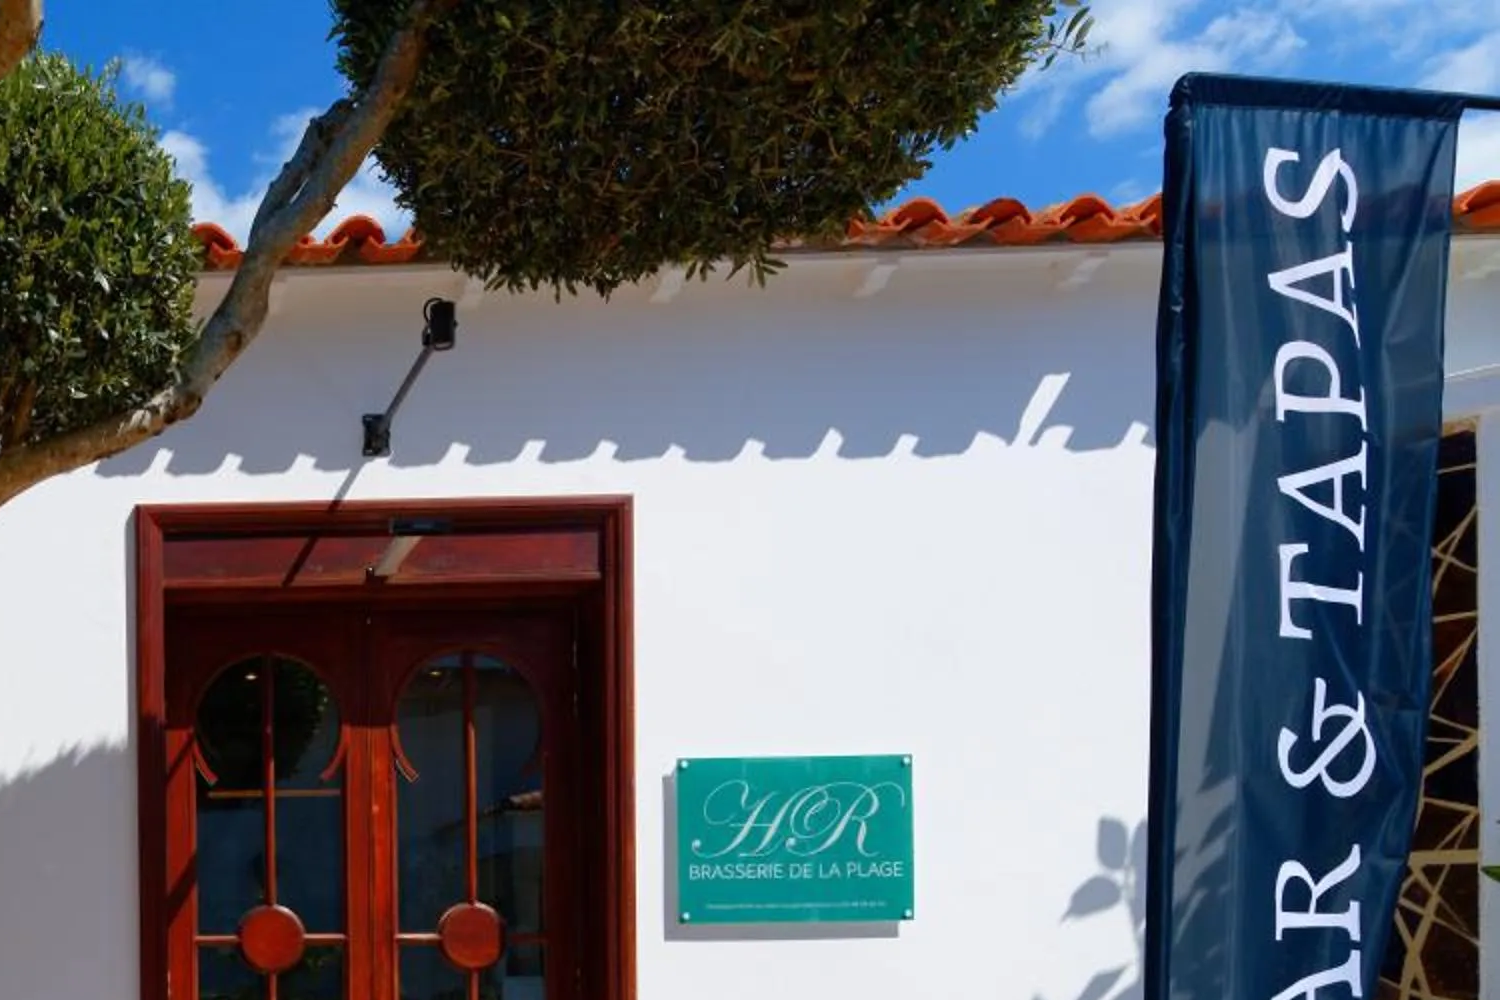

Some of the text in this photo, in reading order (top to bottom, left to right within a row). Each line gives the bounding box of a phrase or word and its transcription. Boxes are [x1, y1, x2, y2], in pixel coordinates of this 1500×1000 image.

[1263, 147, 1368, 640] TAPAS
[1277, 677, 1377, 798] &
[689, 861, 904, 881] BRASSERIE DE LA PLAGE
